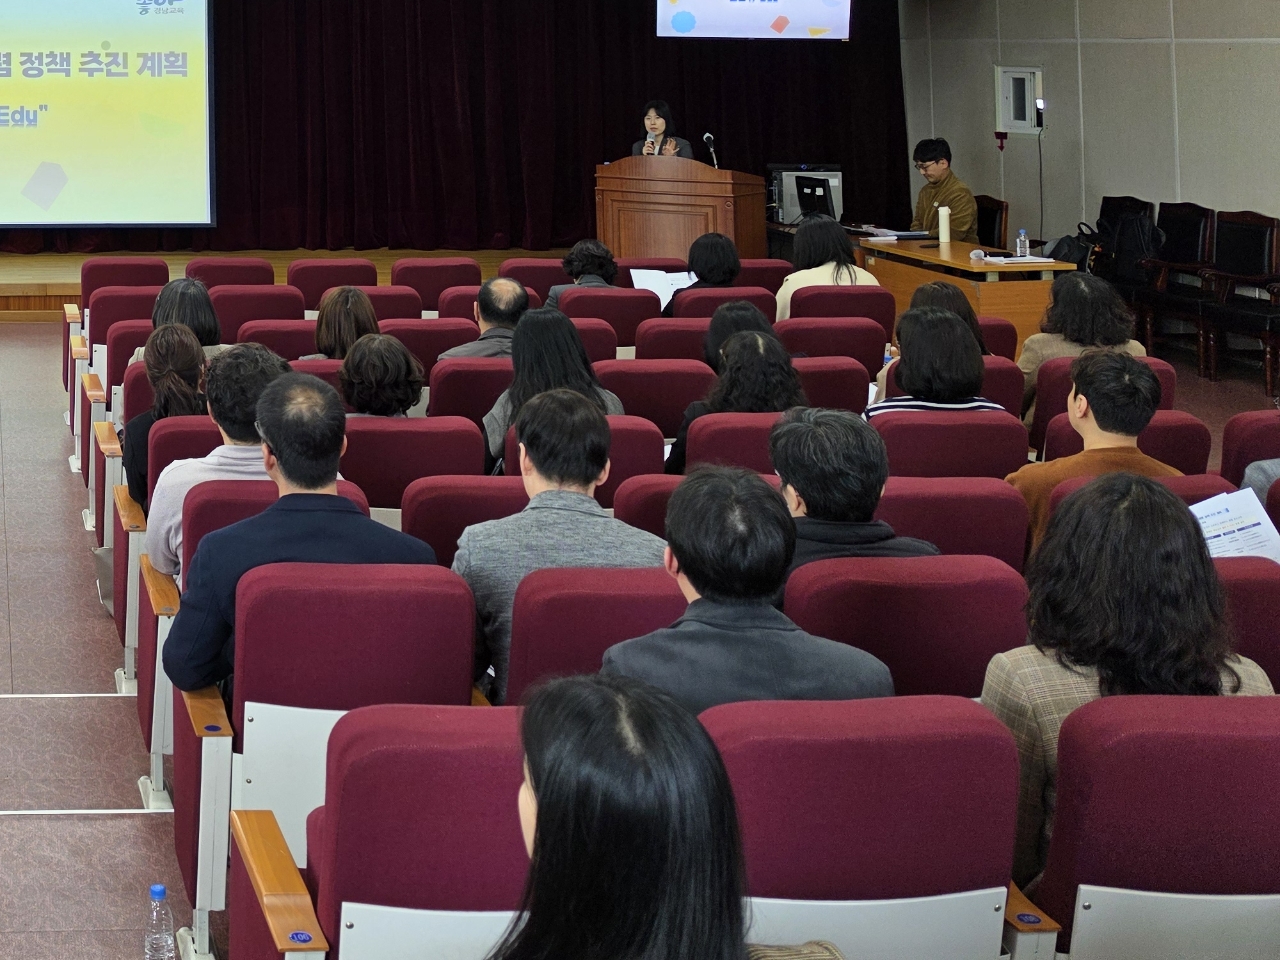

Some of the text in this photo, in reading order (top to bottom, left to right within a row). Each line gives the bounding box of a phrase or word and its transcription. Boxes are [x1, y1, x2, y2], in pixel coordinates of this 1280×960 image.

[19, 51, 71, 79] 정책
[78, 51, 129, 78] 추진
[136, 51, 188, 78] 계획
